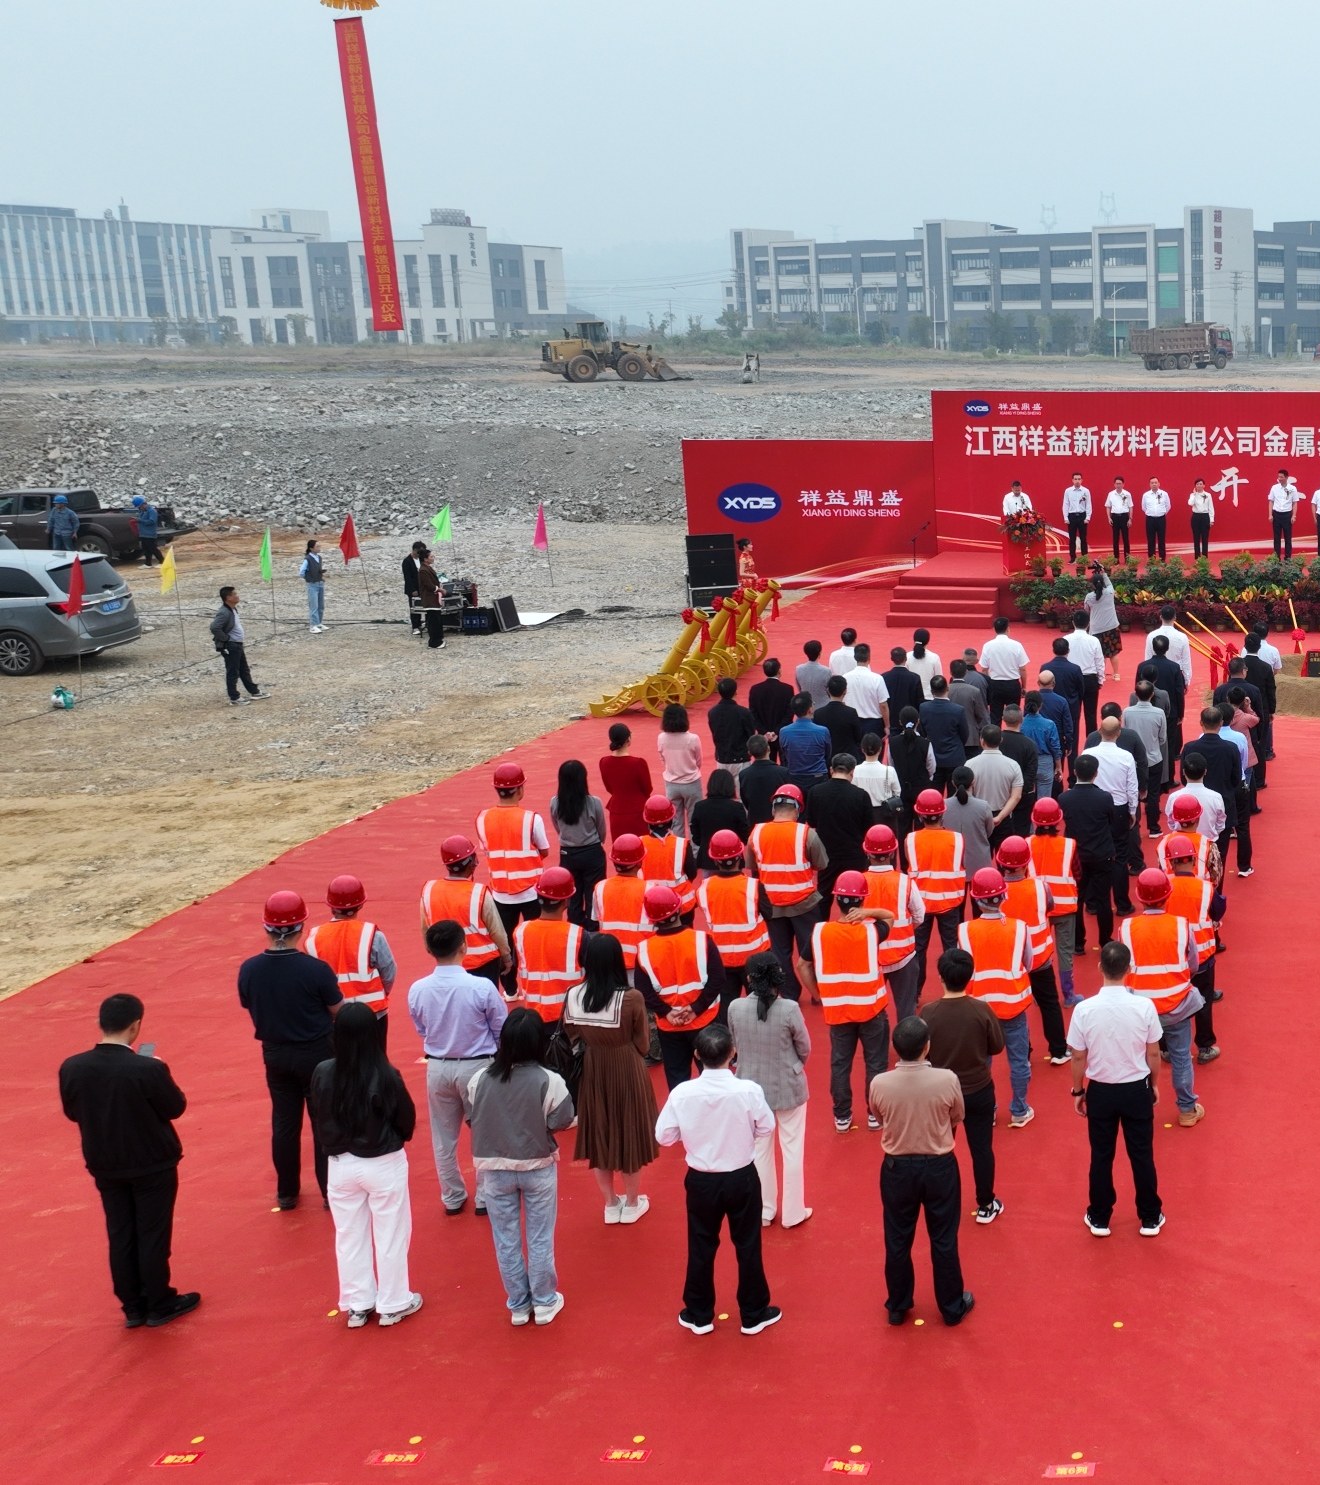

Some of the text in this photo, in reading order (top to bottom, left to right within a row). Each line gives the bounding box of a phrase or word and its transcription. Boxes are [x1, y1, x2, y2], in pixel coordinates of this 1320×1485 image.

[998, 402, 1043, 411] 祥益鼎盛
[724, 497, 777, 510] XYDS
[797, 489, 904, 507] 祥益鼎盛
[802, 508, 900, 517] XIANG YI DING SHENG
